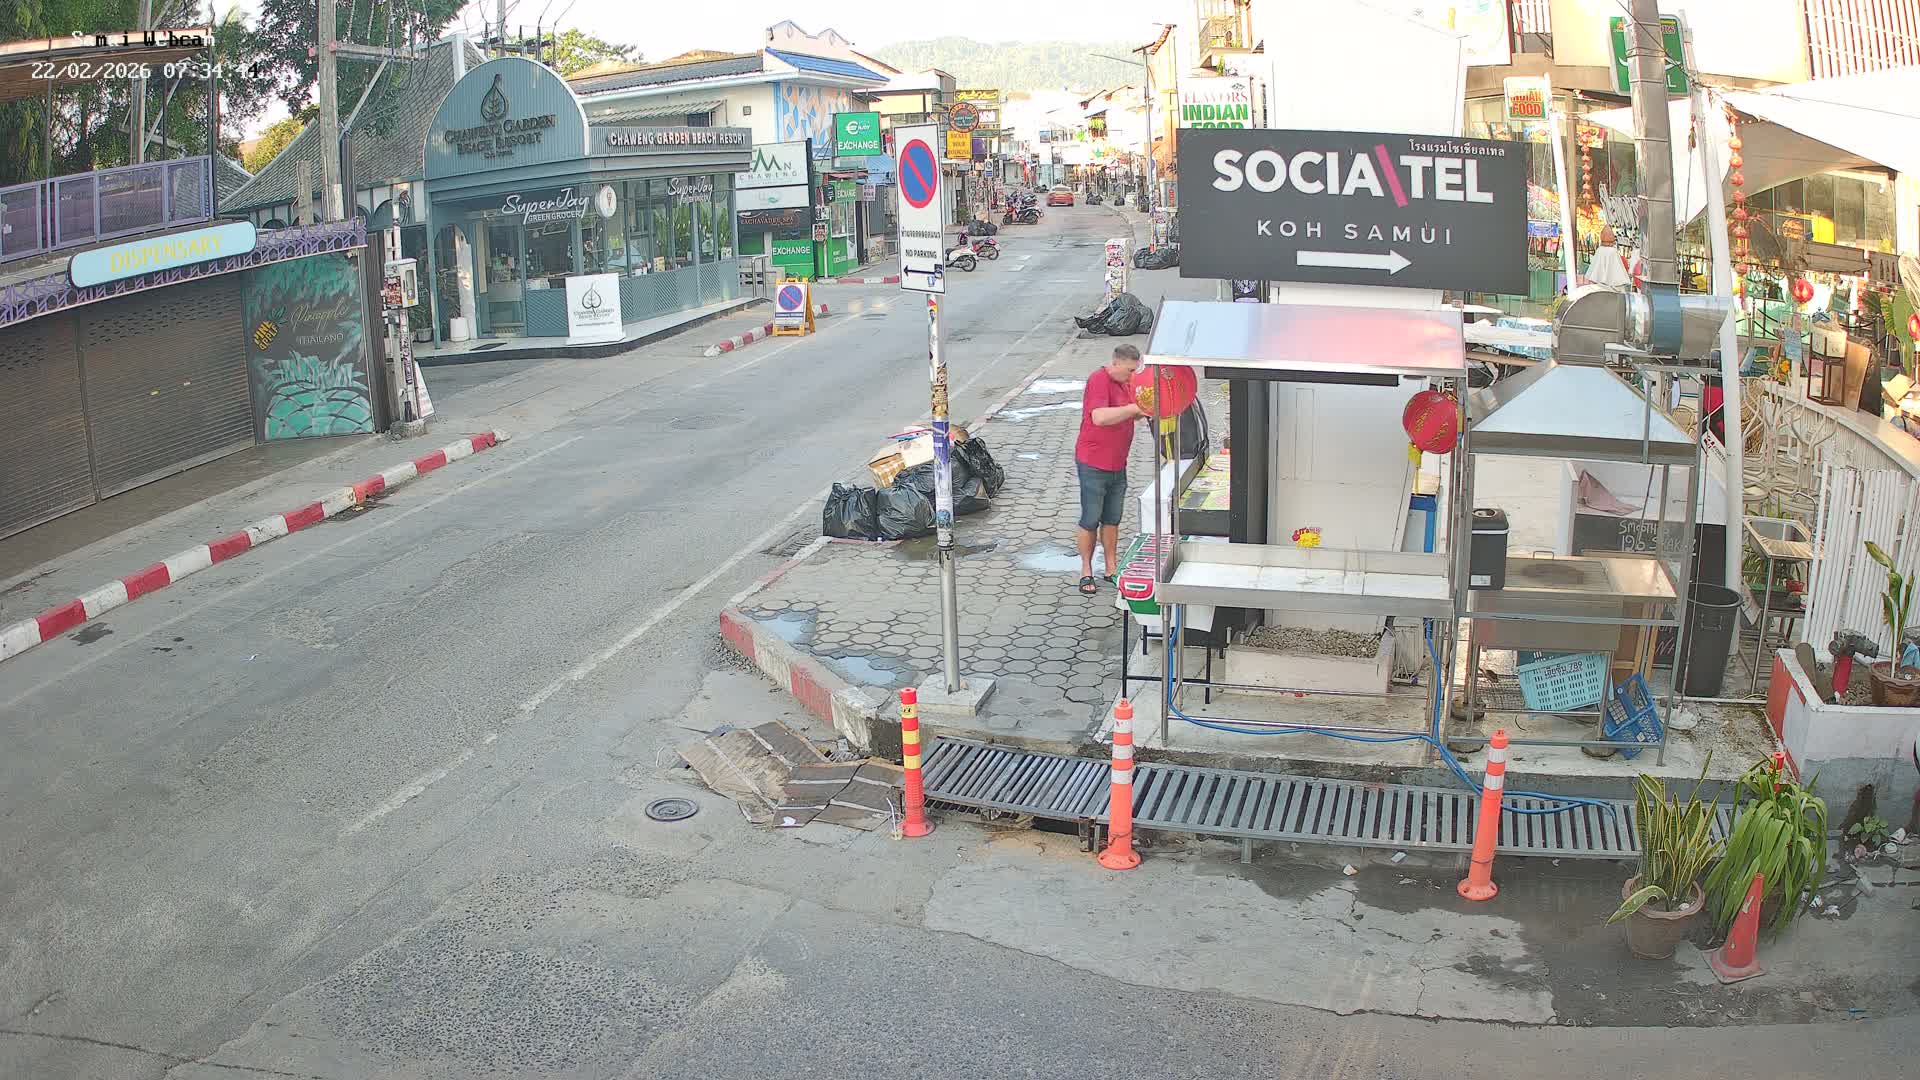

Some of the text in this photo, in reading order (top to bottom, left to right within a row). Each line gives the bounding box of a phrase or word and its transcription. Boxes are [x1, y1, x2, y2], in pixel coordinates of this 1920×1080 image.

[1510, 90, 1542, 102] INDIAN
[1182, 104, 1248, 120] INDIAN
[1512, 102, 1542, 116] FOOD
[503, 114, 556, 133] GARDEN
[610, 132, 746, 146] CHAWENG GARDEN BEACH RESORT
[838, 141, 879, 150] EXCHANGE
[739, 171, 799, 181] CHAWENG
[668, 176, 713, 206] SuperJay
[501, 188, 589, 225] SuperJay
[528, 210, 581, 222] GREEN GROCER
[1257, 219, 1451, 246] KOH SAMUI
[111, 233, 223, 273] DISPENSARY
[772, 246, 811, 256] EXCHANGE
[905, 249, 938, 259] NO PARKING
